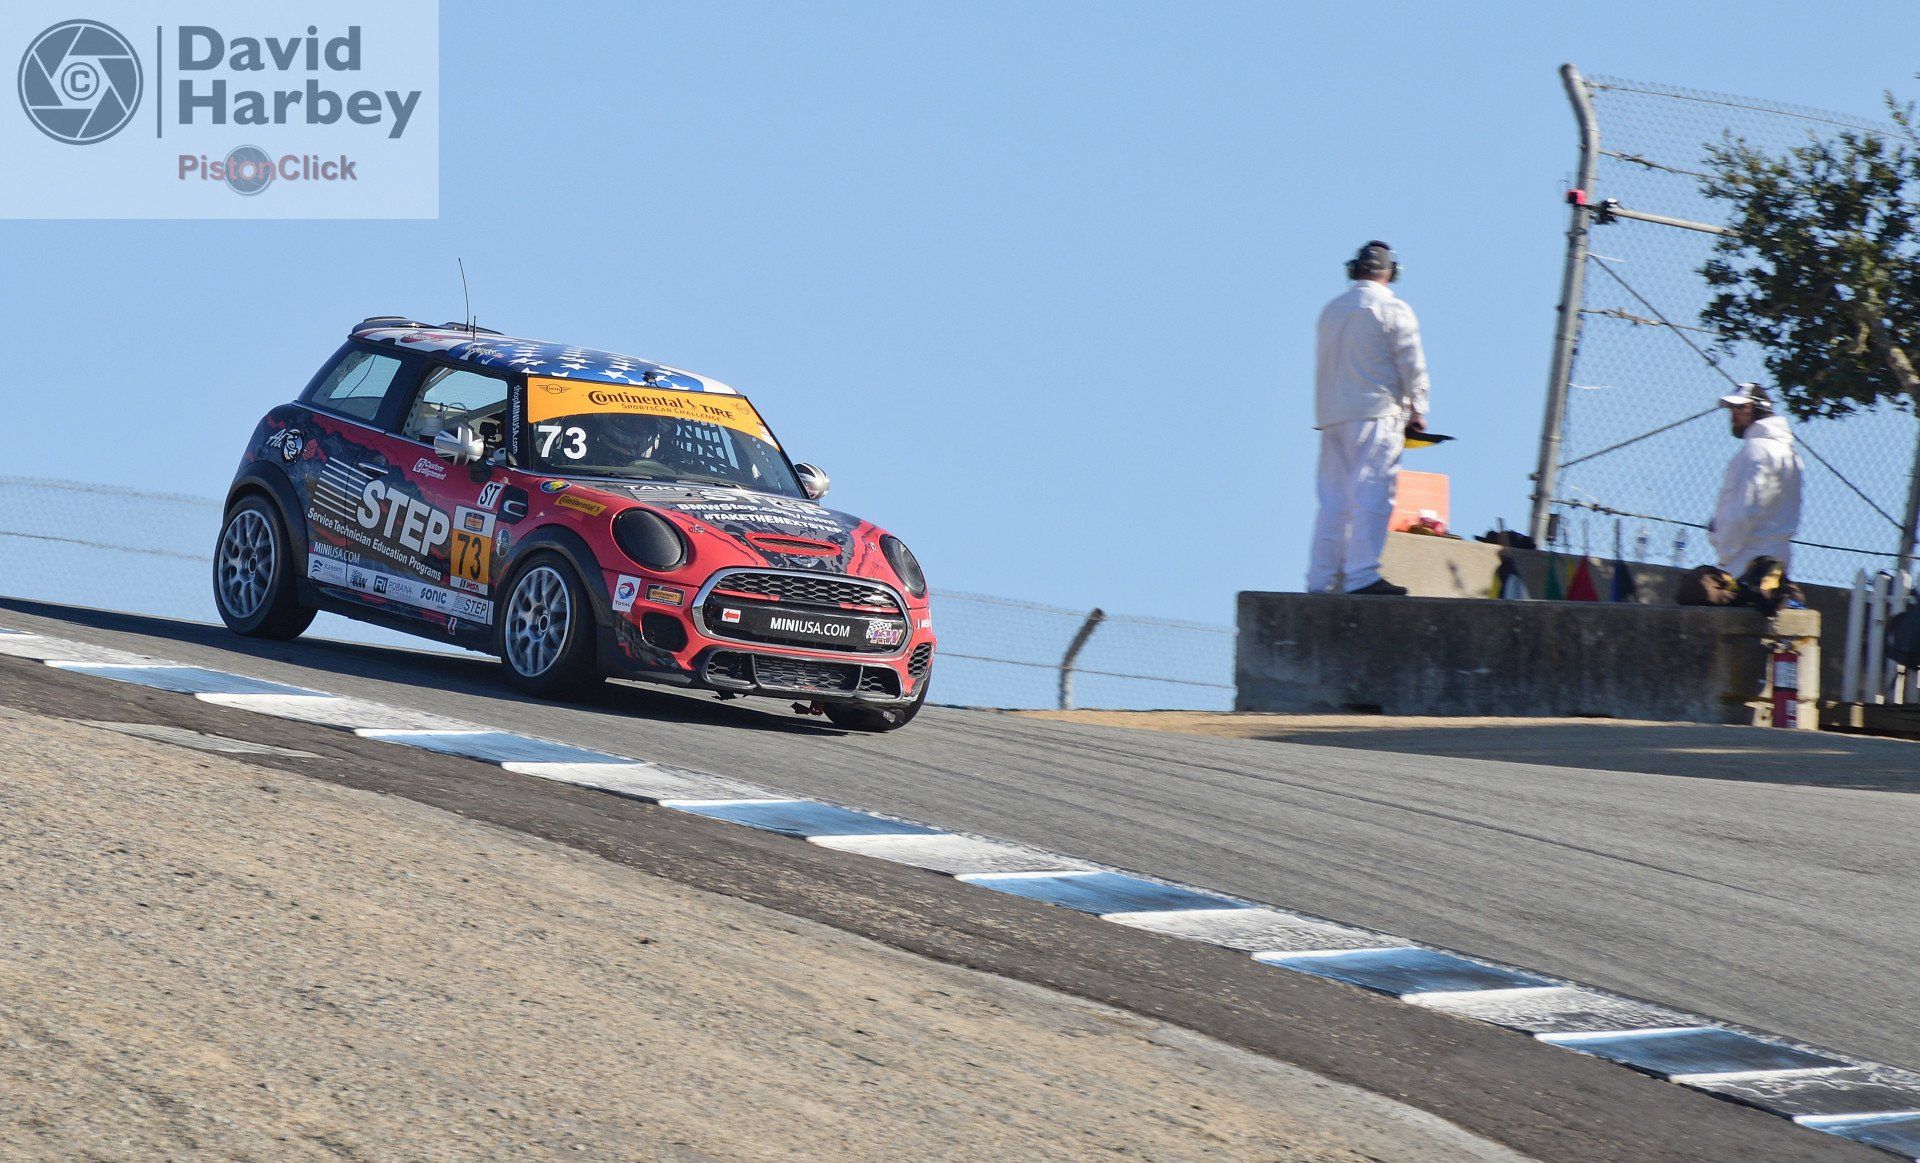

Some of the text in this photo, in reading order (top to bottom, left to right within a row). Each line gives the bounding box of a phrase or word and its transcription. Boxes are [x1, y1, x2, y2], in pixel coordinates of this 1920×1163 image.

[588, 391, 735, 420] Continental TIRE
[538, 425, 587, 460] 73
[480, 483, 500, 506] ST
[357, 480, 450, 557] STEP
[704, 513, 843, 533] #TAKETHENEXTSTEP
[307, 507, 442, 581] Service Technician Education Programs
[313, 541, 360, 564] MINIUSA.COM
[457, 533, 482, 580] 73
[464, 599, 487, 614] STEP
[615, 600, 630, 608] TOTAL
[770, 617, 850, 638] MINIUSA.COM
